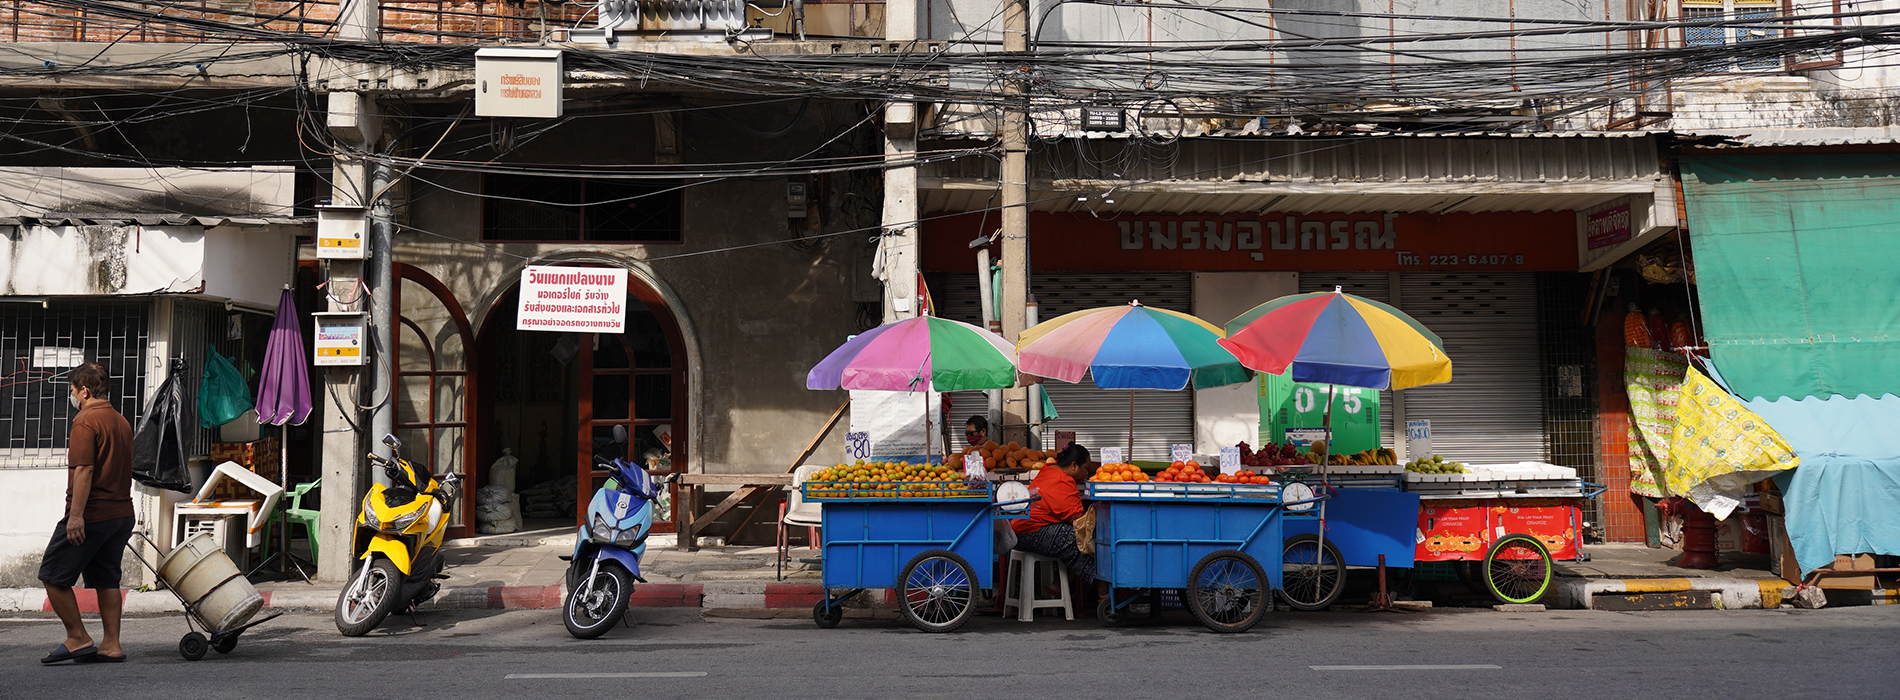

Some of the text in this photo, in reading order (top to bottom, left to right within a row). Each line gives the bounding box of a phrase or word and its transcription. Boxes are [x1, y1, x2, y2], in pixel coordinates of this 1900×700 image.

[1117, 213, 1398, 262] ชมรมอุปกรณ์
[1395, 251, 1423, 266] โทร.
[529, 269, 616, 286] วินแยกแปลงนาม
[537, 287, 609, 301] มอเตอร์ไซค์ รับจ้าง
[524, 301, 620, 314] รับส่งของและเอกสารทั่วไป
[522, 318, 621, 328] กรุณาอย่าจอดรถขวางทางวิน
[1295, 387, 1362, 414] 075
[853, 438, 871, 459] 80
